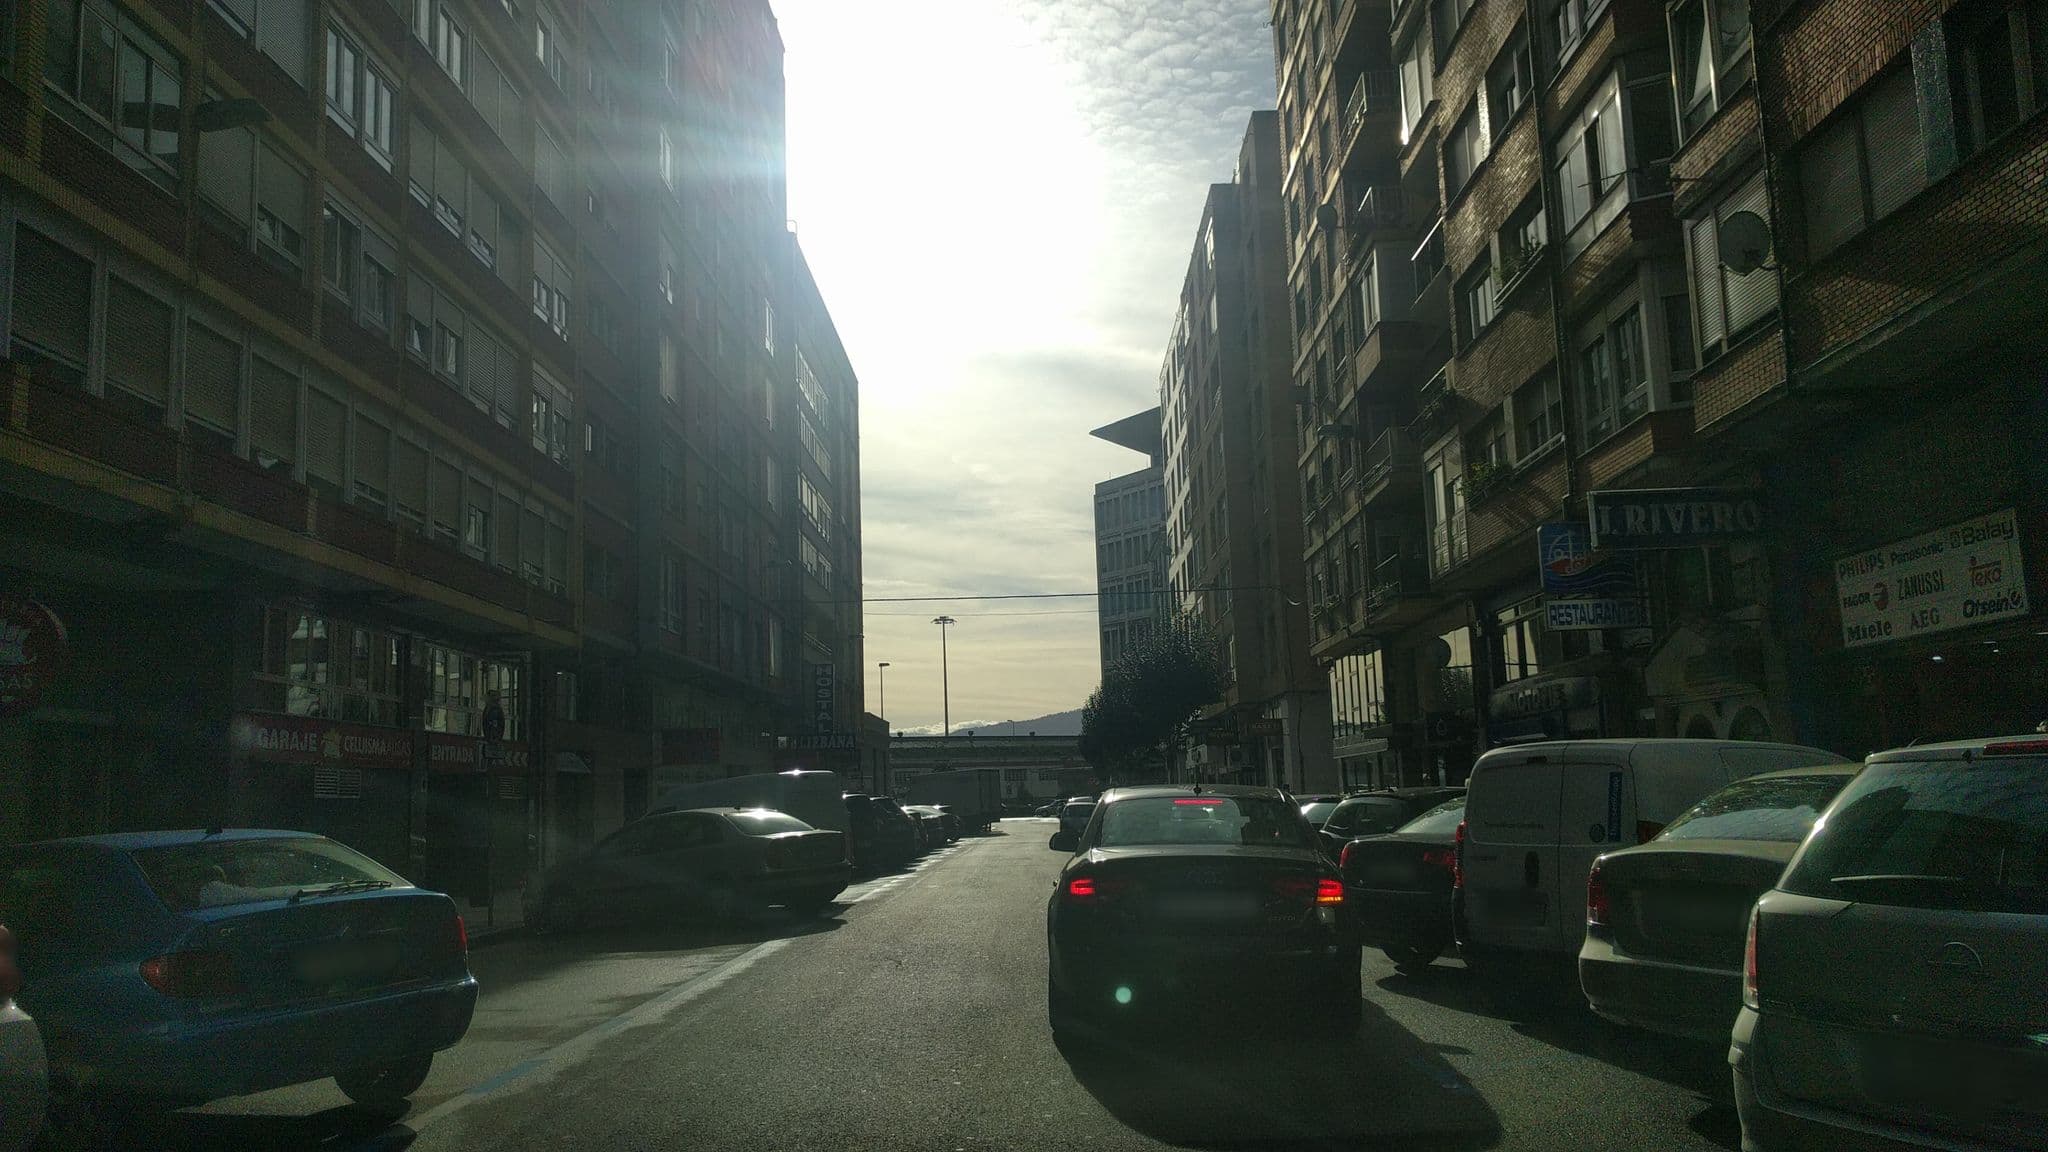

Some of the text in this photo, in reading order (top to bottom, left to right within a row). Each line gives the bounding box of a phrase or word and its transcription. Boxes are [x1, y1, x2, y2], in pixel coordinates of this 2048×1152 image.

[1623, 499, 1761, 535] RIVERO
[1838, 520, 2013, 576] PHILIPS Panasonic Balay
[1898, 569, 1944, 601] ZANUSSI
[1847, 620, 1892, 642] Miele
[1911, 607, 1939, 628] AEG
[816, 665, 832, 736] HOSTAL
[258, 727, 318, 752] GARAJE
[431, 744, 474, 763] ENTRADA
